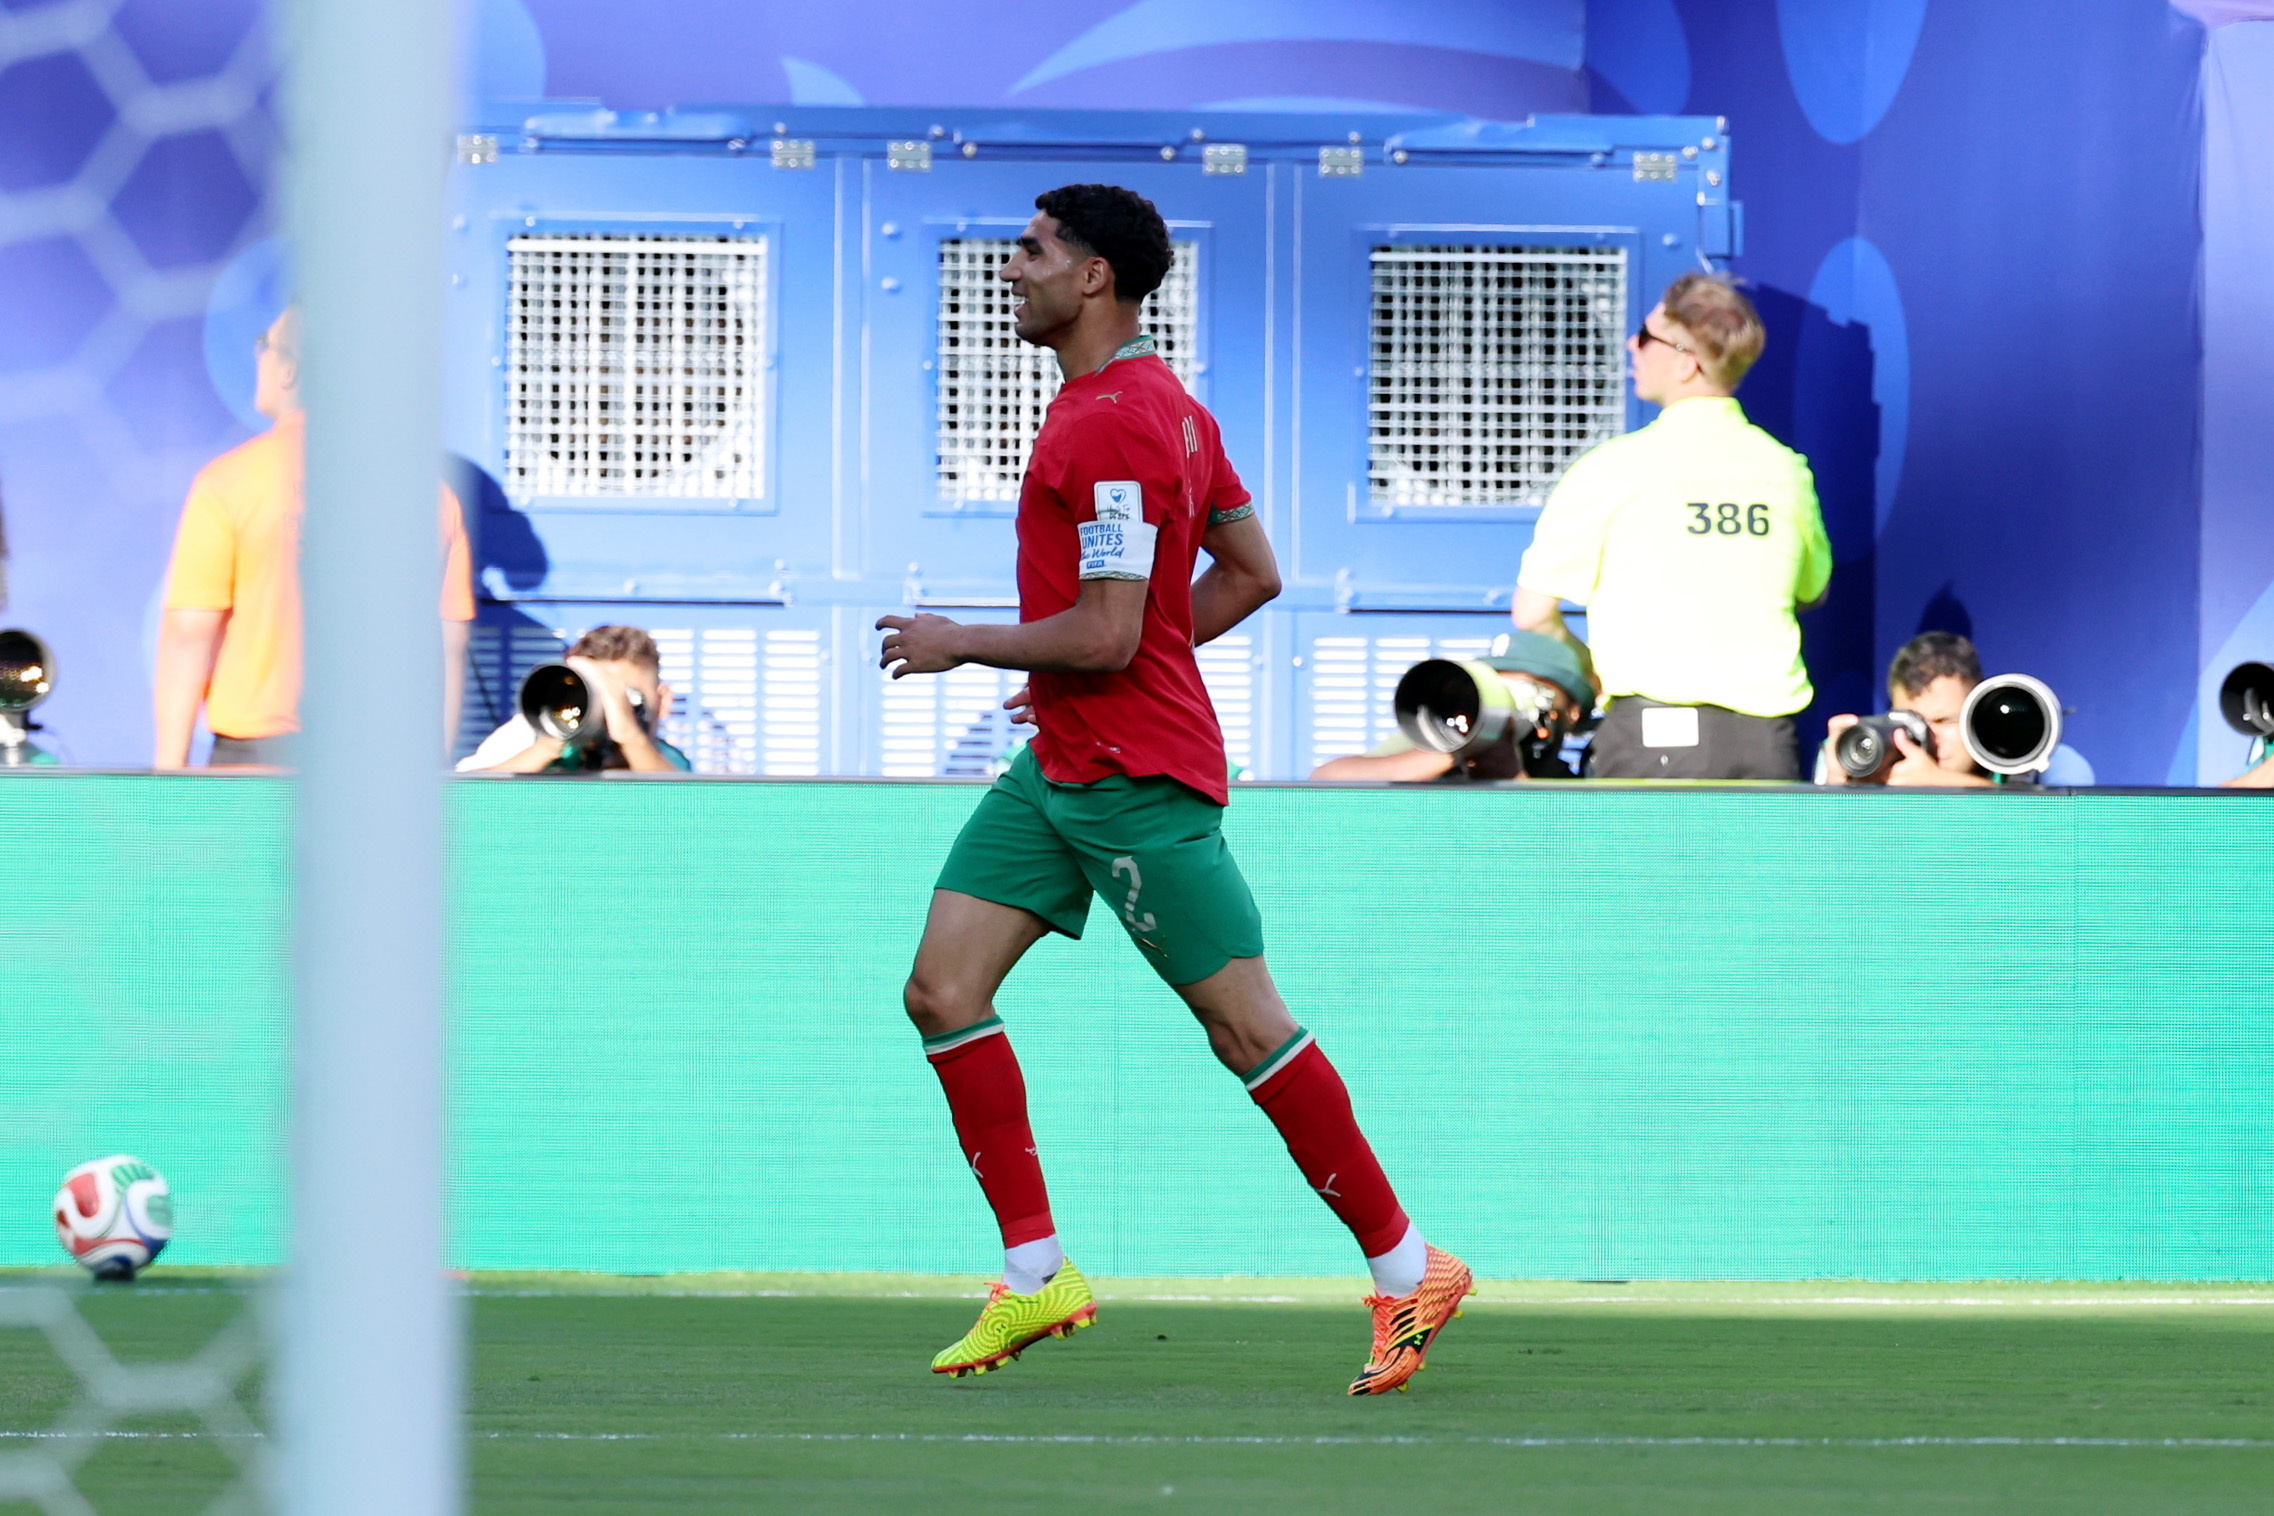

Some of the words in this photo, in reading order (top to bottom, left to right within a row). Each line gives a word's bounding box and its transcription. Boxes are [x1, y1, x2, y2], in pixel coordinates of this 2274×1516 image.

[1687, 502, 1769, 536] 386
[1080, 524, 1123, 536] FOOTBALL
[1082, 533, 1123, 549] UNITES
[1091, 547, 1124, 558] World
[1087, 560, 1104, 568] FIFA
[1111, 856, 1157, 932] 2
